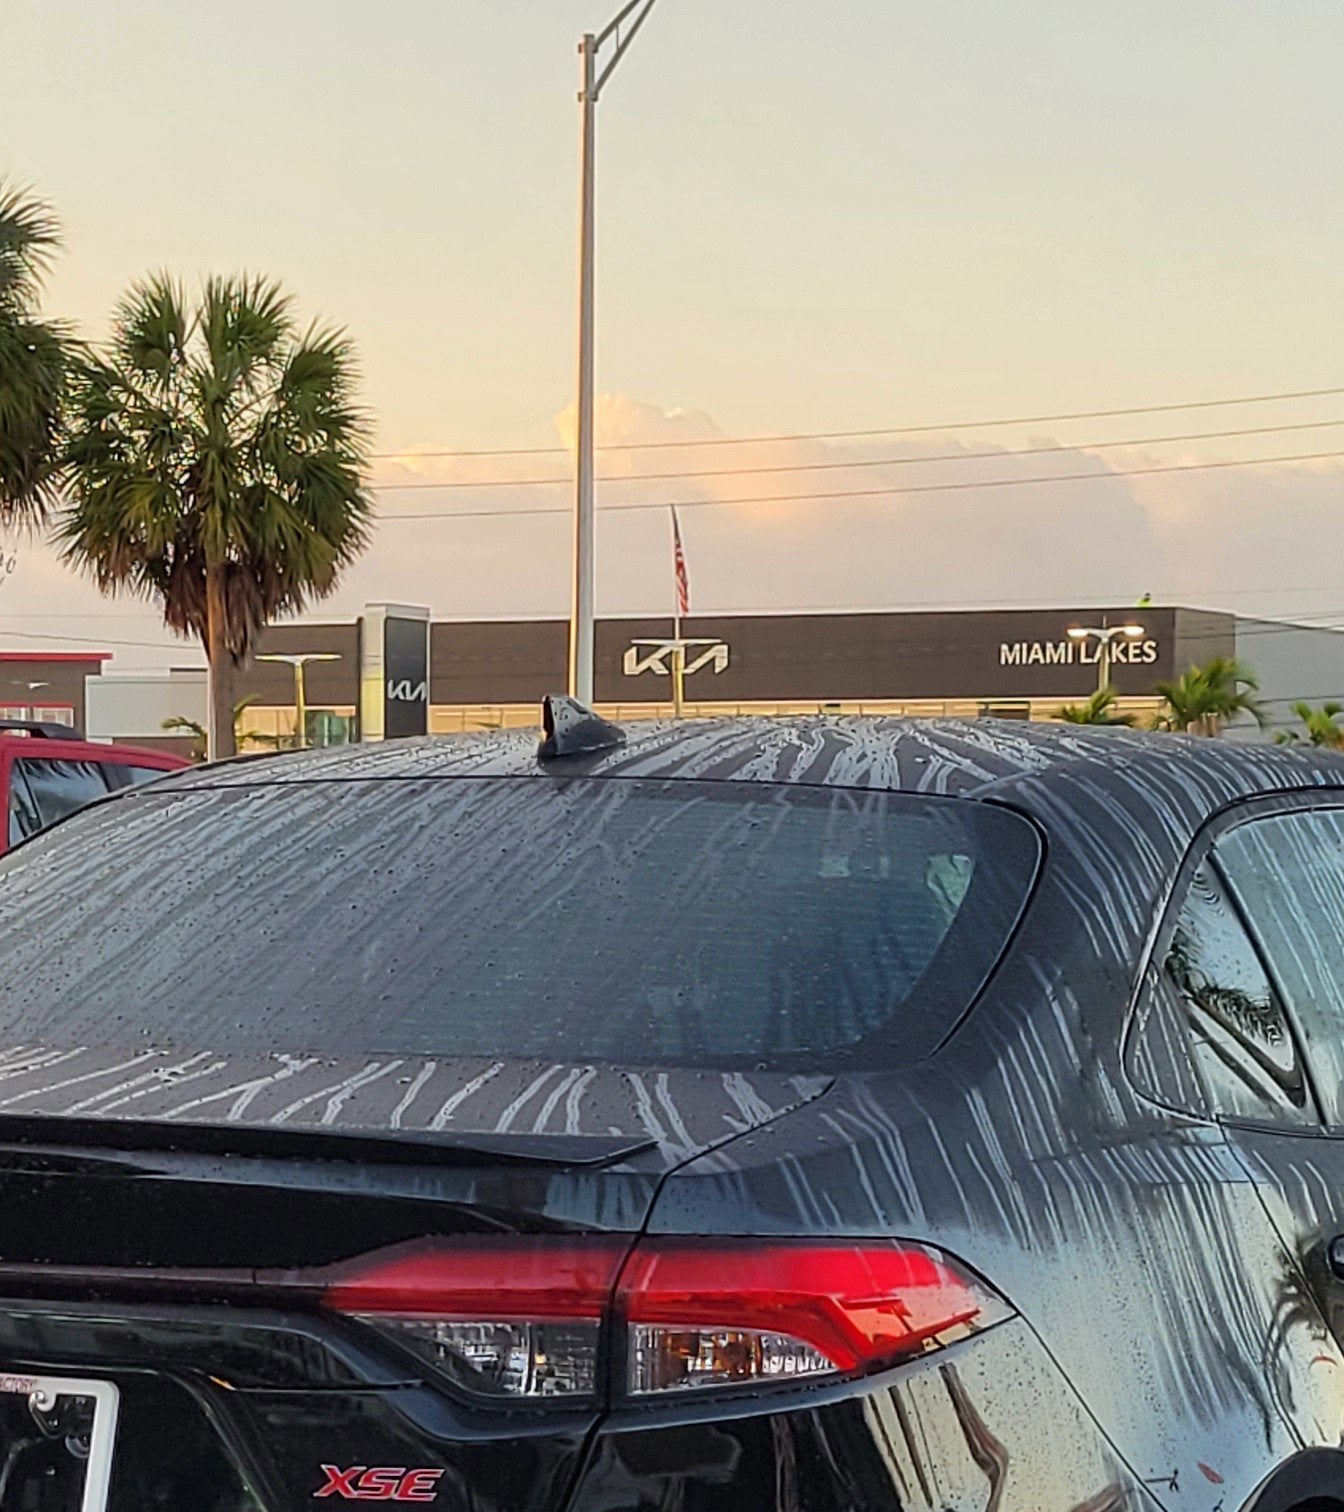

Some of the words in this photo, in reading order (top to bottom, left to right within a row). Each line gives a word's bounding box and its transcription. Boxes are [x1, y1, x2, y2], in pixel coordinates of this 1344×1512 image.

[1000, 642, 1073, 665] MIAMI
[1079, 640, 1157, 664] LAKES
[387, 679, 428, 701] KIA
[313, 1464, 446, 1502] XSE
